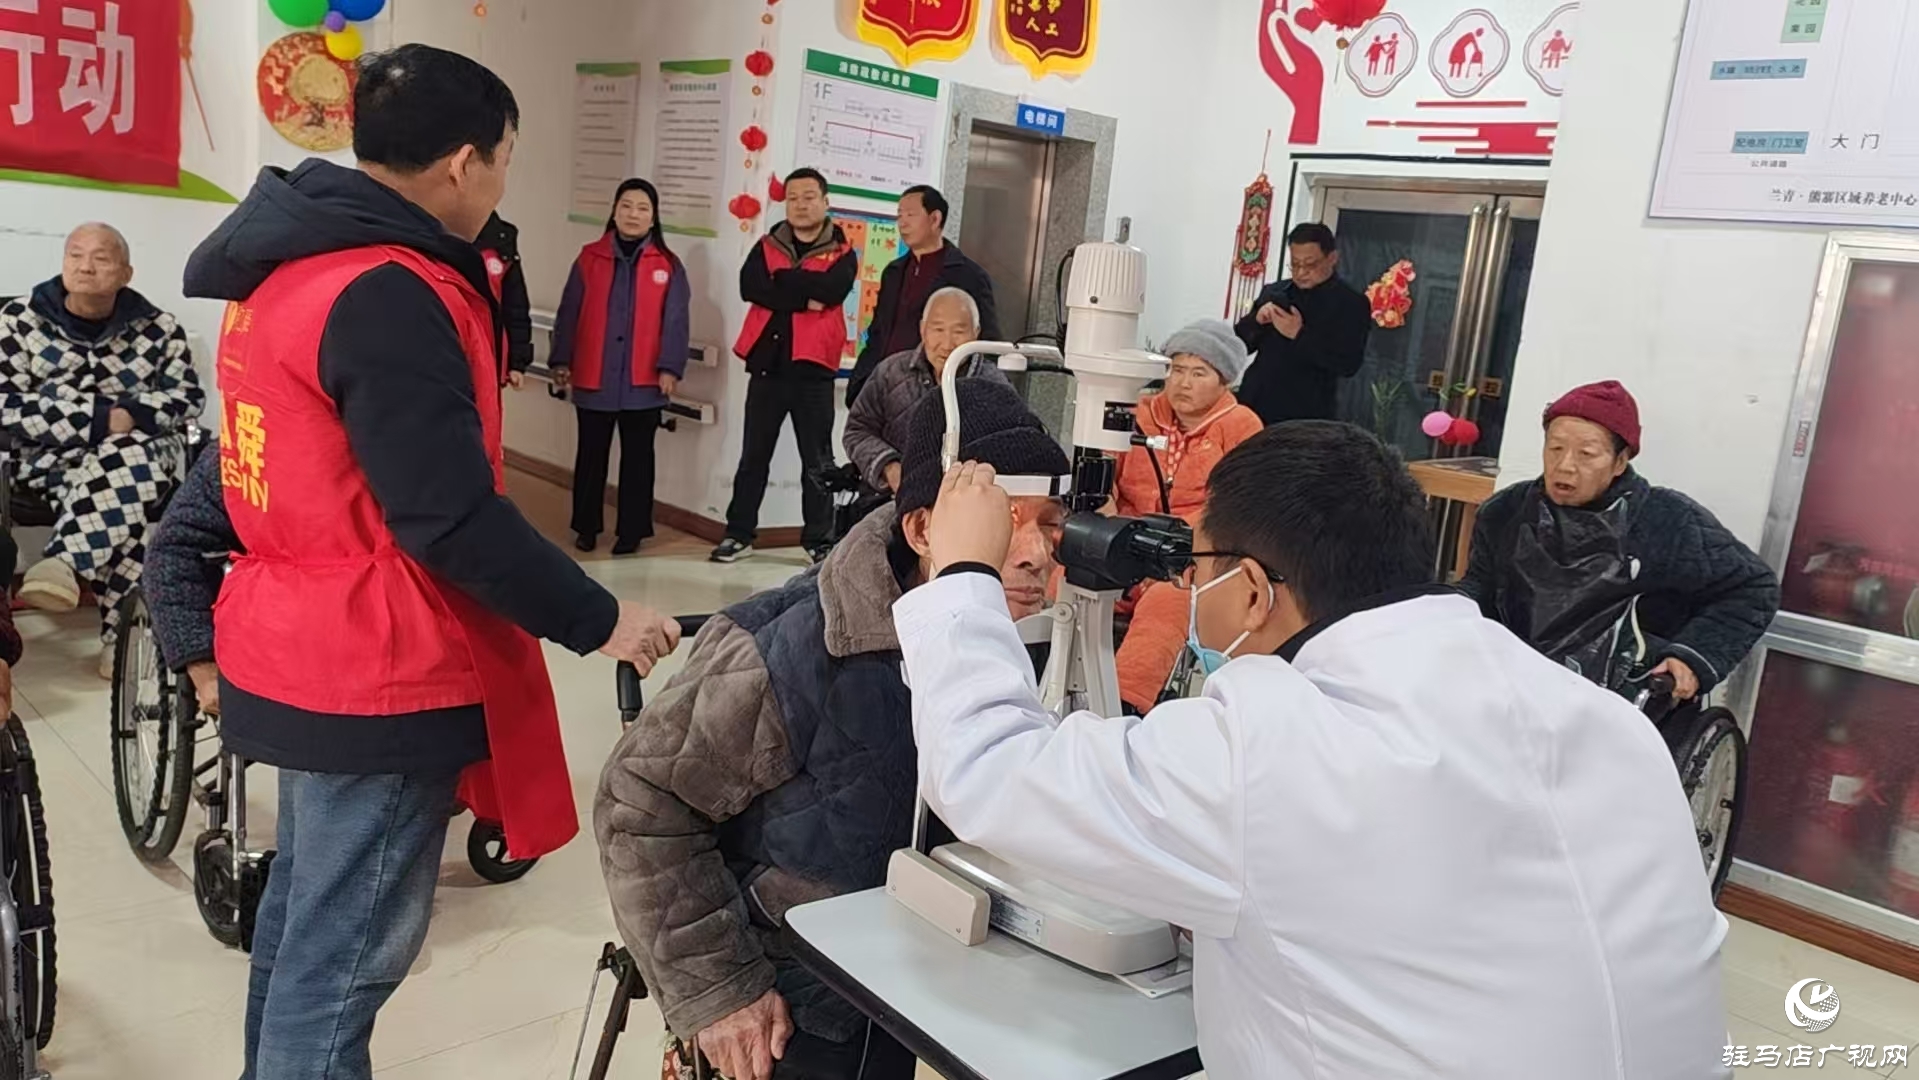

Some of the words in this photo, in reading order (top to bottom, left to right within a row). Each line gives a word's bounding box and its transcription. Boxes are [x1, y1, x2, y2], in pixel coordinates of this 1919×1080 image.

[812, 82, 833, 109] 1F
[1024, 109, 1058, 129] 电梯间
[1831, 133, 1880, 149] 大门
